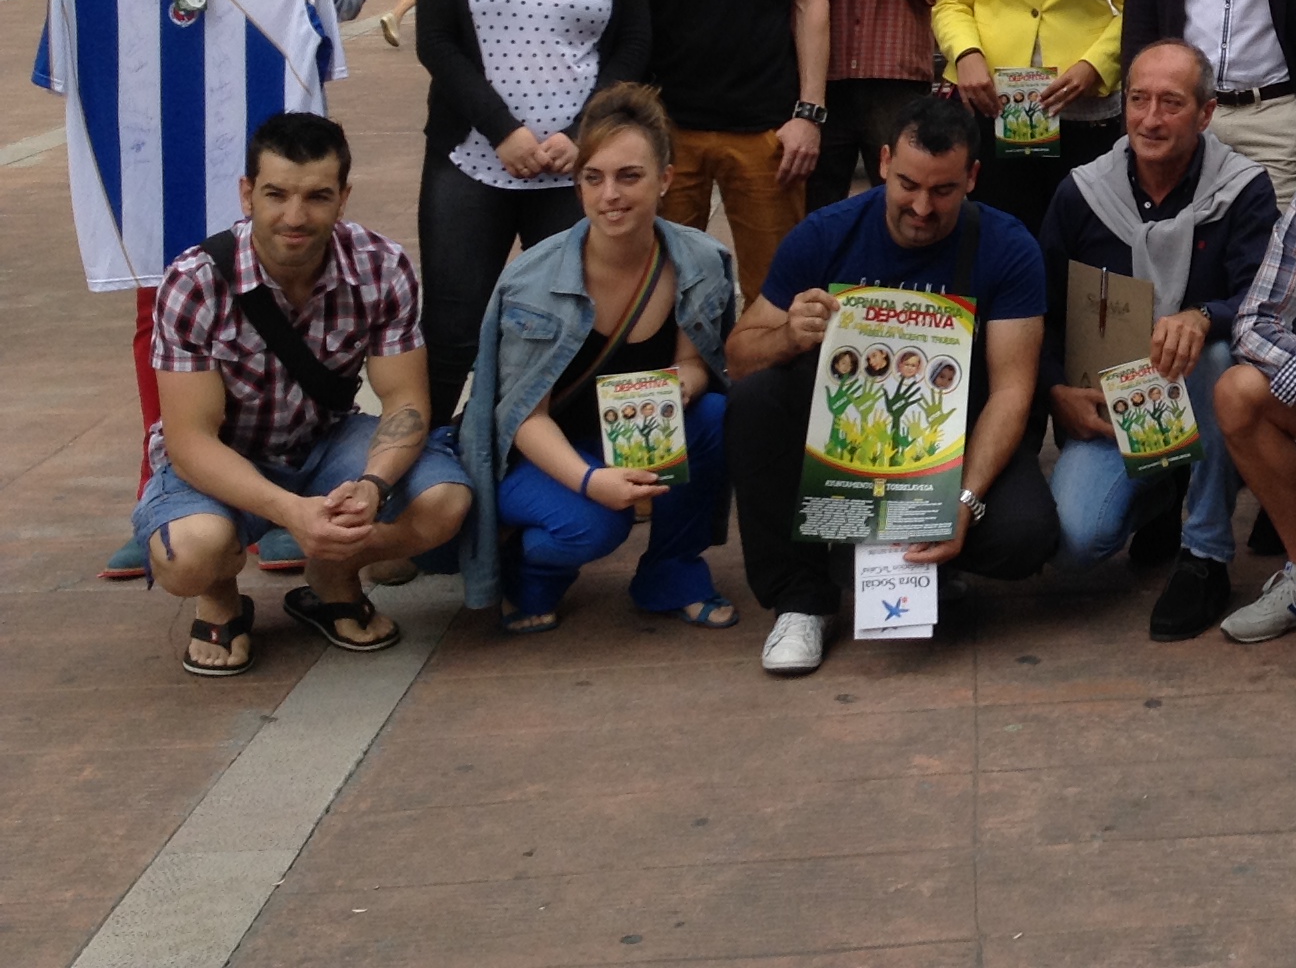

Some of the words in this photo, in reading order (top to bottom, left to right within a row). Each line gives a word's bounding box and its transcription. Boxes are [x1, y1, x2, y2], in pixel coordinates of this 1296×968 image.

[842, 296, 897, 309] JORNADA
[902, 301, 964, 319] SOLIDARIA
[864, 306, 955, 330] DEPORTIVA
[861, 578, 896, 592] Social
[899, 575, 930, 588] Obra
